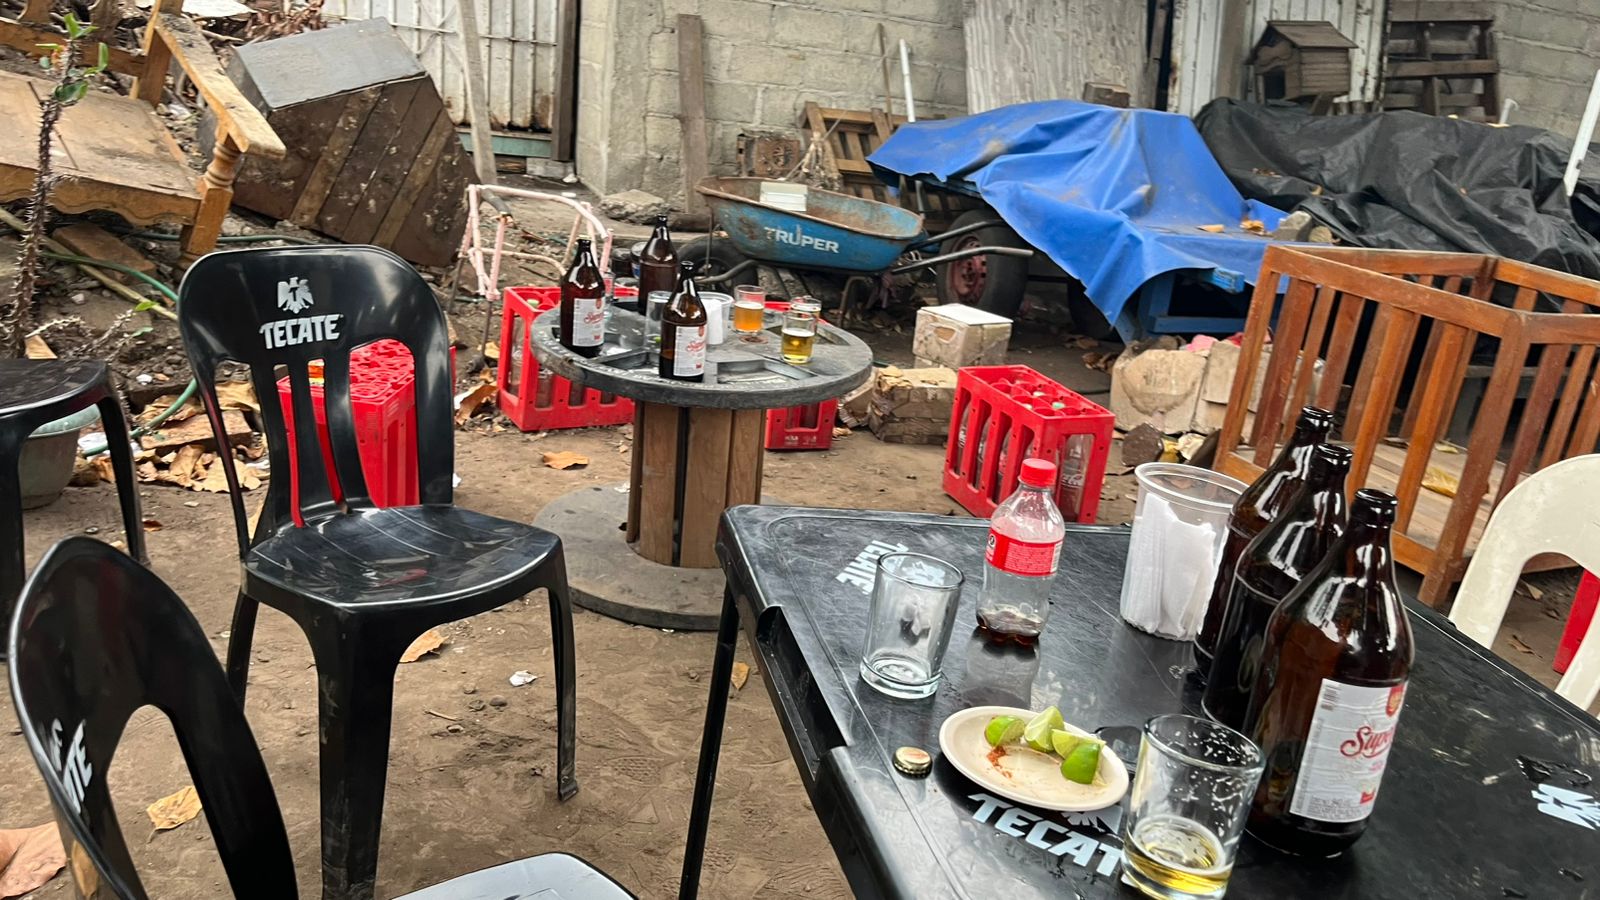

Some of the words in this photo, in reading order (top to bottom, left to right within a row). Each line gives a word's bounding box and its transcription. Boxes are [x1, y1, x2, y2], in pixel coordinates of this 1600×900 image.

[764, 225, 840, 254] TRUPER
[259, 314, 344, 350] TECATE
[968, 793, 1138, 888] TECAT
